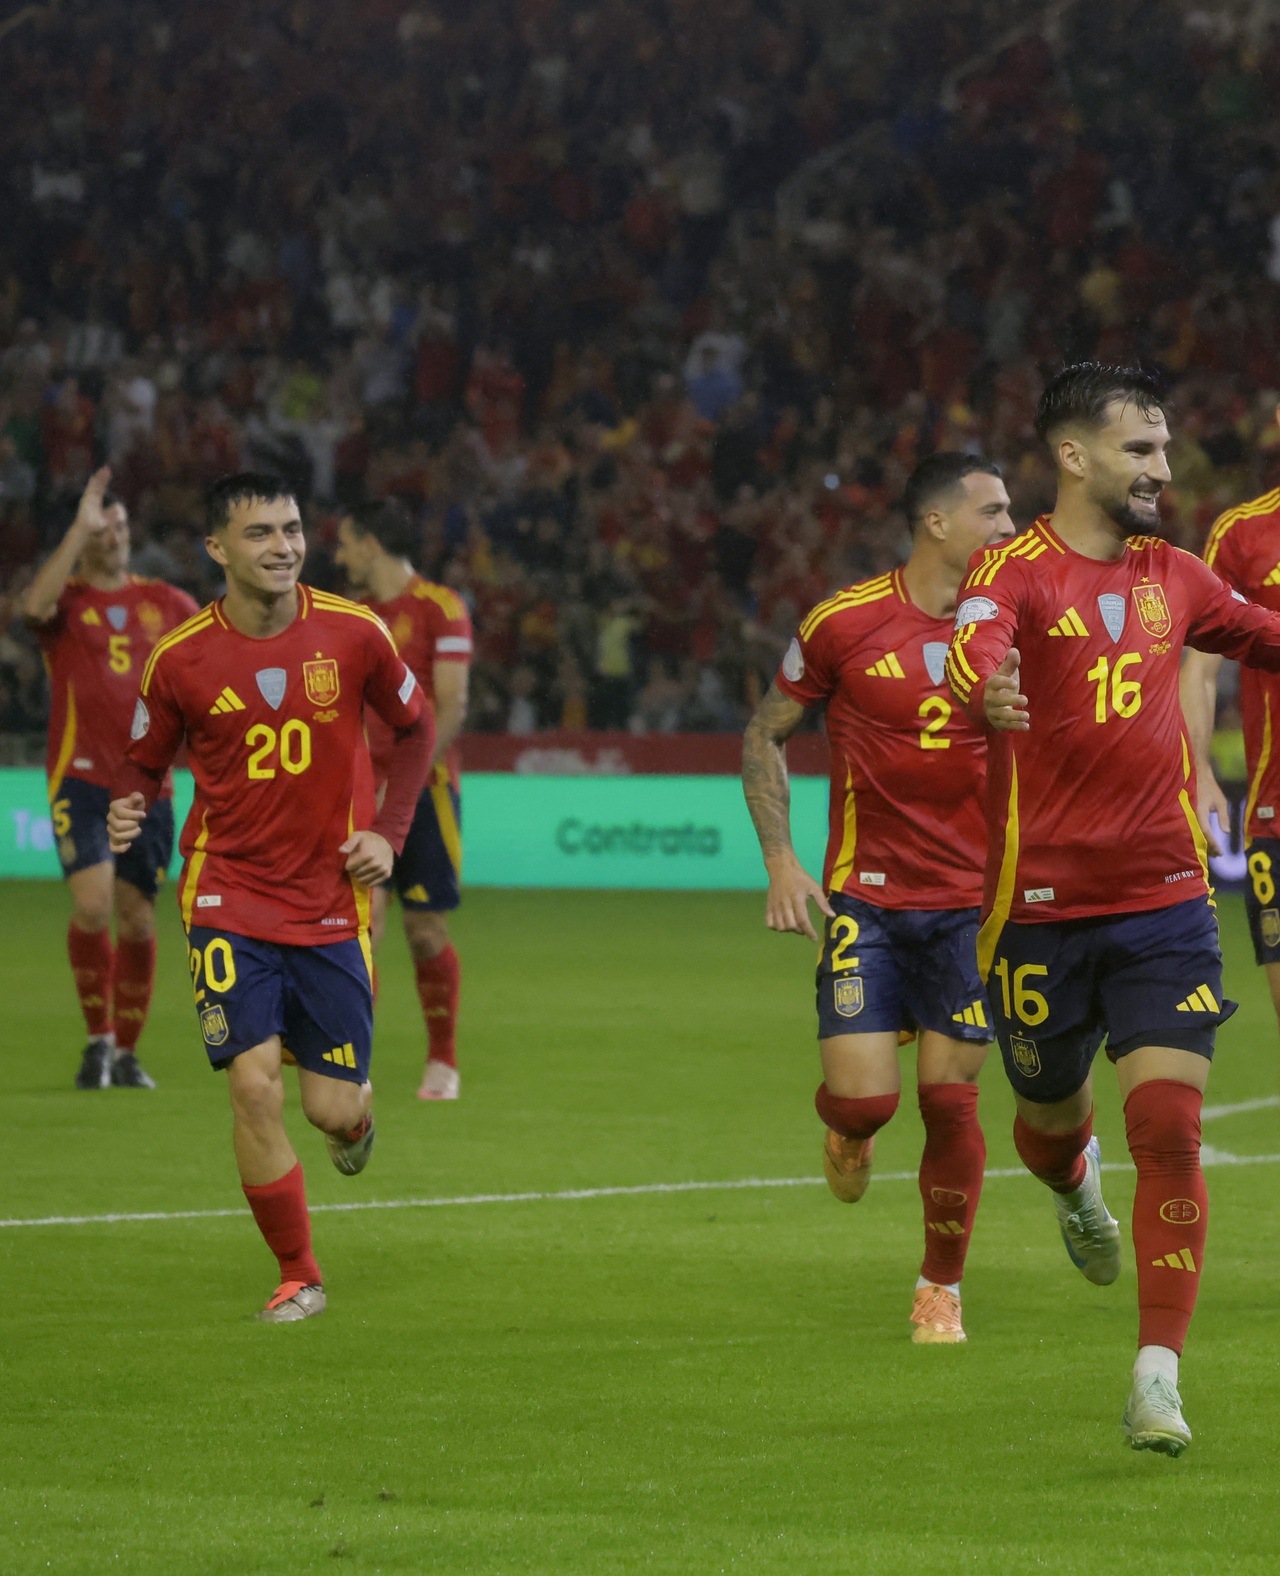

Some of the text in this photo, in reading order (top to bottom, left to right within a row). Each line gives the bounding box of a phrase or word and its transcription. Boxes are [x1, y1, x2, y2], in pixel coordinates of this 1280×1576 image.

[109, 635, 131, 674] 5
[1087, 651, 1143, 723] 16
[245, 718, 312, 780] 20
[918, 695, 952, 749] 2
[52, 799, 71, 836] 5
[555, 818, 722, 857] Contrata
[1249, 851, 1275, 905] 8
[190, 937, 237, 1004] 20
[831, 914, 860, 972] 2
[995, 956, 1050, 1027] 16
